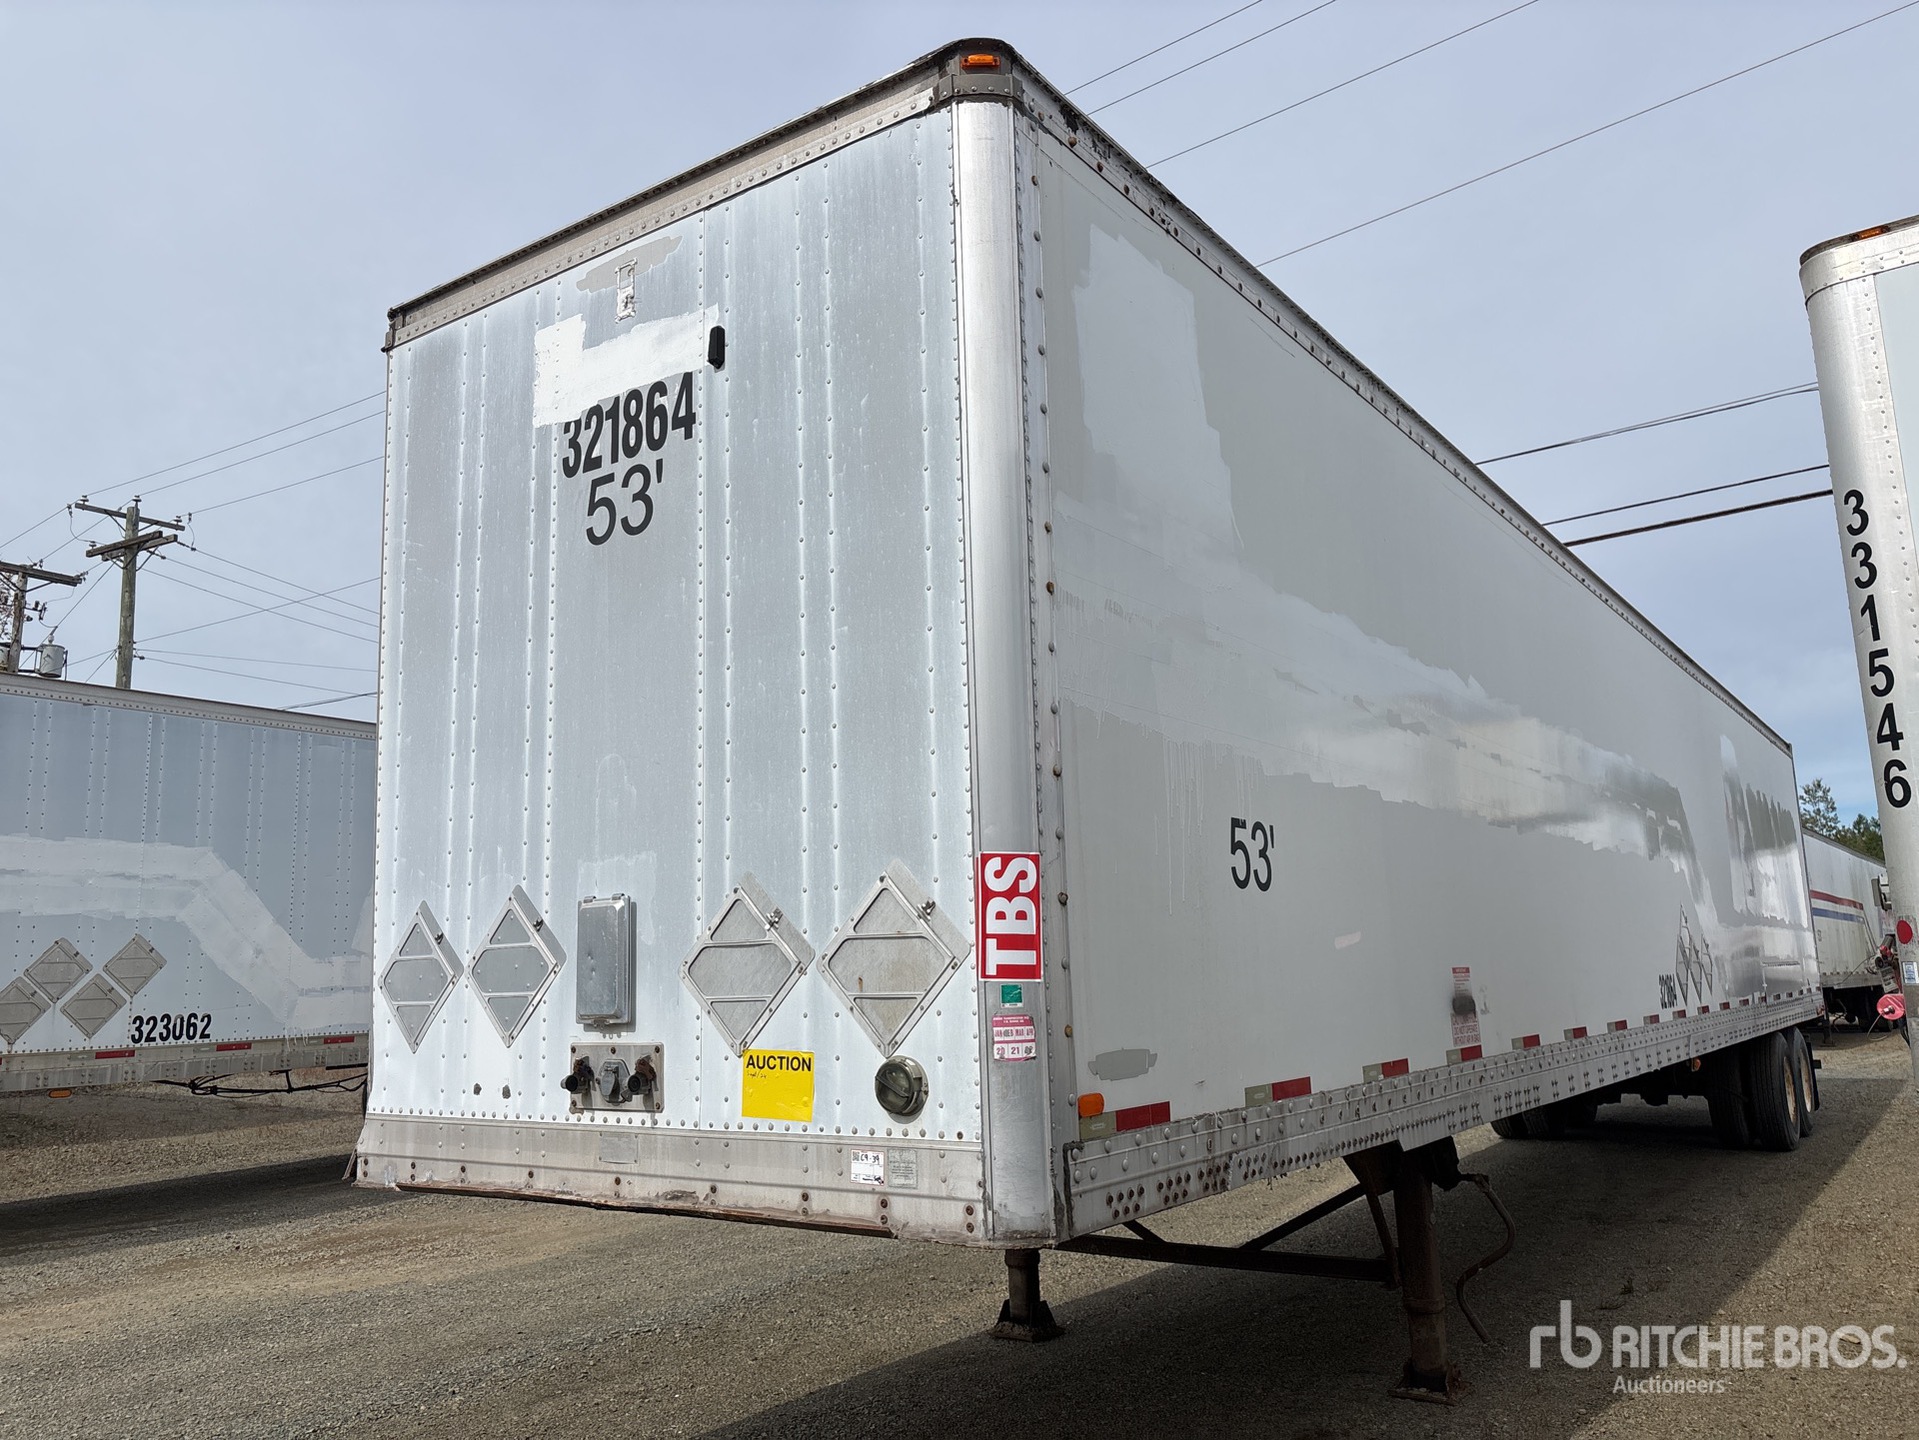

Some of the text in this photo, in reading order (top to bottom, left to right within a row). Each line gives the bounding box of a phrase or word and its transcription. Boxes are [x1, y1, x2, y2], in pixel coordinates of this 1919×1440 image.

[562, 371, 697, 479] 321864
[586, 458, 664, 546] 53'
[1843, 489, 1912, 809] 331546
[1230, 816, 1275, 892] 53'
[984, 856, 1038, 976] TBS
[131, 1012, 213, 1044] 323062
[746, 1054, 812, 1072] AUCTION
[1011, 1046, 1020, 1055] 21
